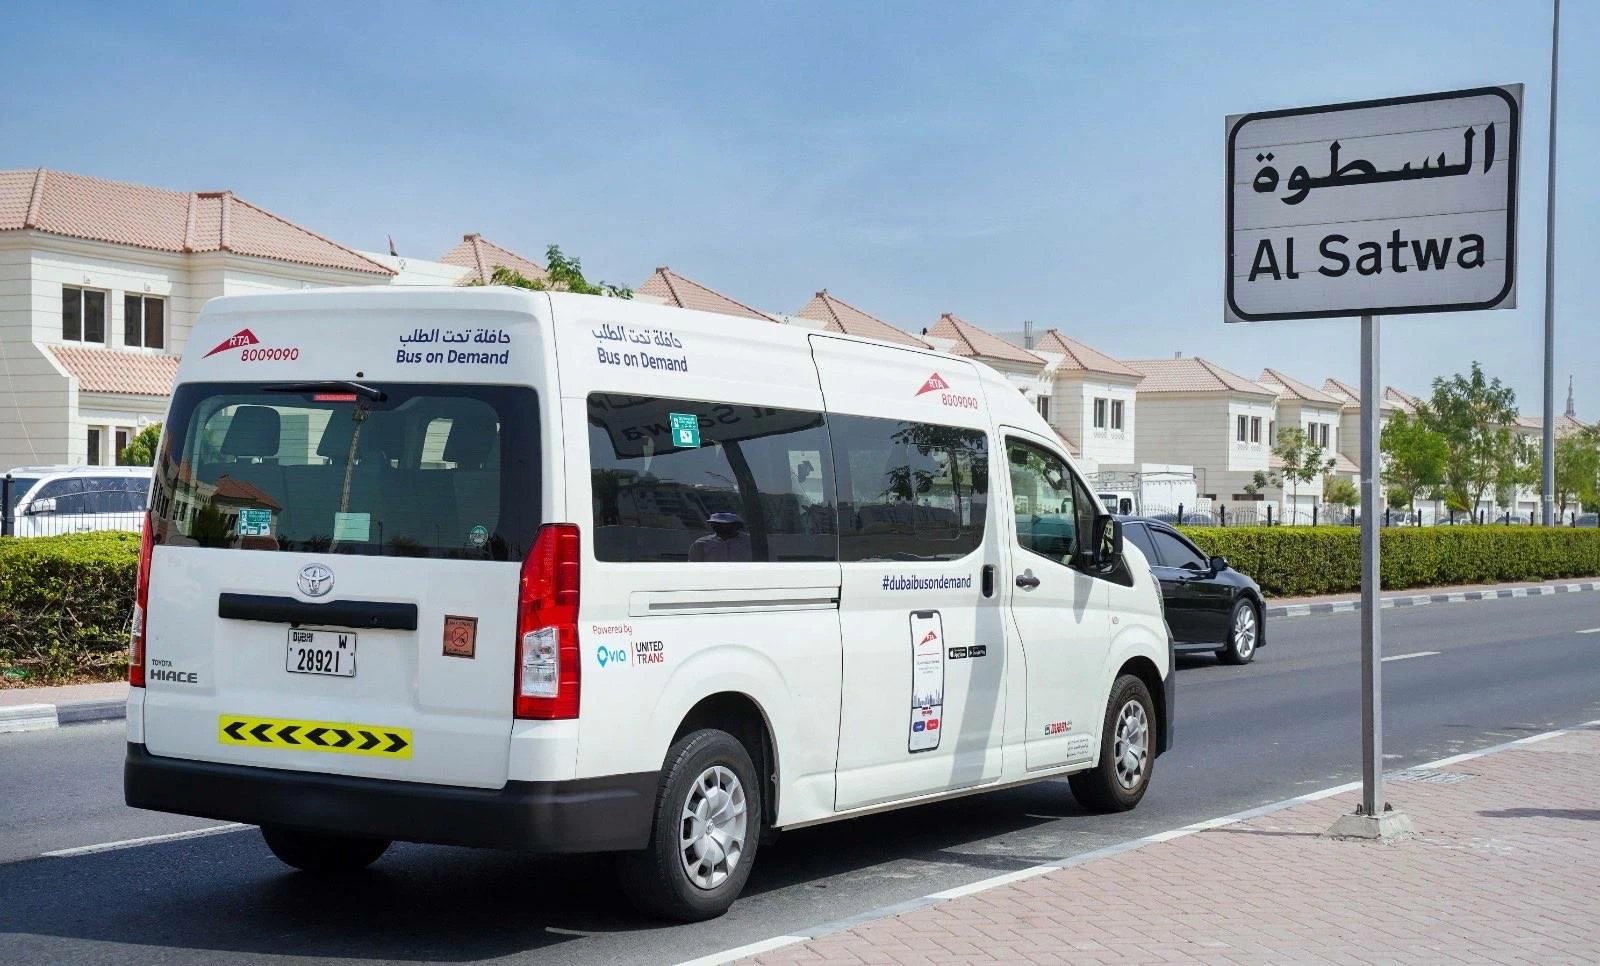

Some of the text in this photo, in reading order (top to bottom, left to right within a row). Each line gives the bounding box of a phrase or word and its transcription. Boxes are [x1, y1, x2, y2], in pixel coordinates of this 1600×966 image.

[1253, 121, 1496, 205] السطوة
[1248, 228, 1486, 282] Al Satwa
[229, 335, 251, 347] RTA
[399, 328, 511, 347] حافلة تحت الطلب
[592, 323, 683, 349] حافلة تحت الطلب
[241, 347, 299, 361] 8009090
[396, 349, 510, 365] Bus on Demand
[597, 346, 688, 373] Bus on Demand
[941, 393, 978, 410] 8009090
[882, 574, 972, 591] #dubaibusondemand
[592, 623, 633, 636] Powered by
[338, 634, 348, 649] W
[635, 640, 664, 653] UNITED
[151, 658, 173, 668] TOYOTA
[297, 648, 340, 673] 28921
[636, 653, 665, 665] TRANS
[150, 669, 198, 684] HIACE
